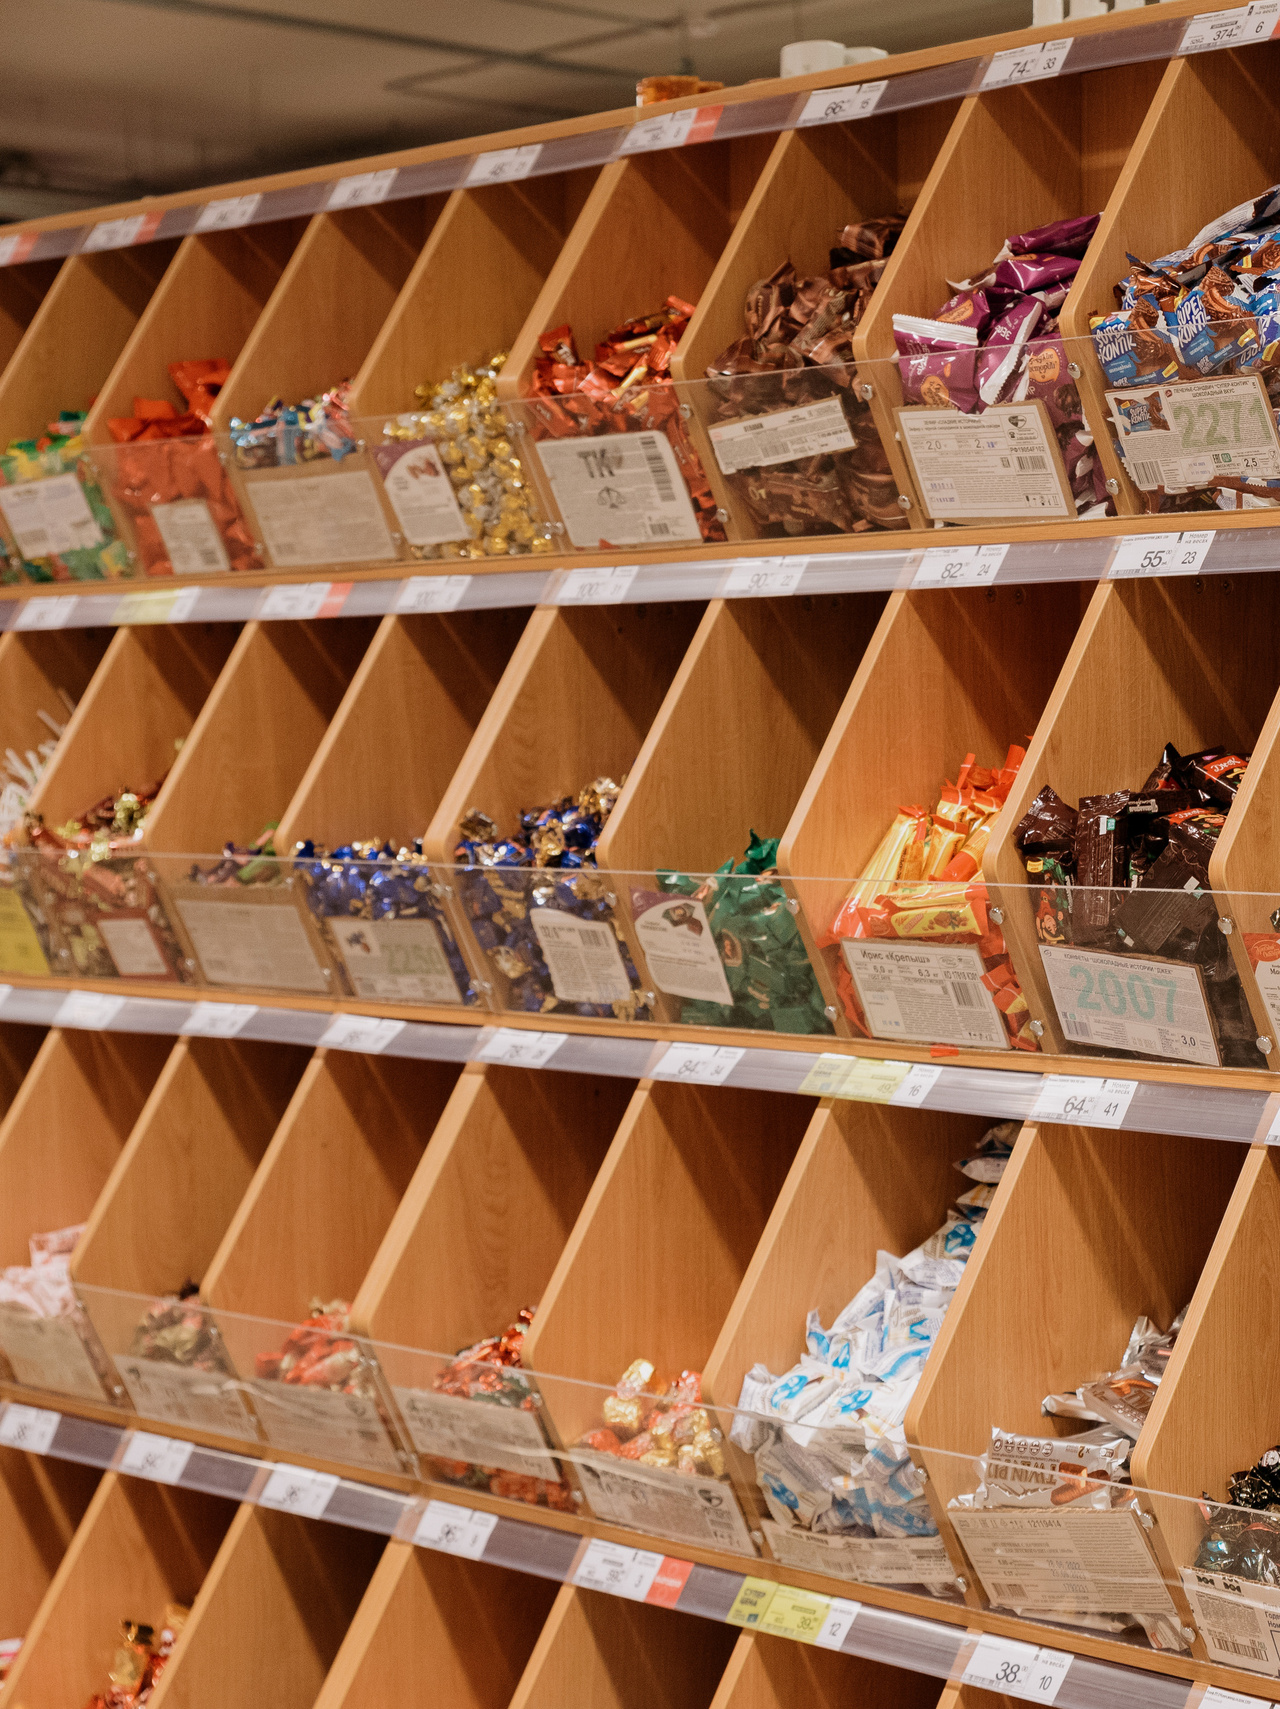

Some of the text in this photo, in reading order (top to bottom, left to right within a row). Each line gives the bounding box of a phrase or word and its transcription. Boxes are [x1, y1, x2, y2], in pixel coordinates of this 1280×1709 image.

[1213, 27, 1233, 41] 374
[1255, 21, 1264, 33] 6
[1173, 398, 1272, 448] 2271
[926, 441, 941, 451] 2,0
[1244, 457, 1257, 468] 2,5
[1141, 550, 1165, 568] 55
[1181, 551, 1197, 565] 23
[941, 562, 963, 579] 82
[977, 563, 990, 577] 24
[861, 950, 930, 964] Ирис «Крепыш»
[1064, 953, 1089, 962] КОНФЕТЫ
[1069, 965, 1177, 1022] 2007
[1181, 1035, 1196, 1047] 3,0
[908, 1085, 922, 1097] 16
[1064, 1096, 1087, 1115] 64
[1104, 1102, 1119, 1117] 41
[829, 1623, 841, 1636] 12
[996, 1661, 1020, 1683] 38
[1039, 1675, 1052, 1690] 10
